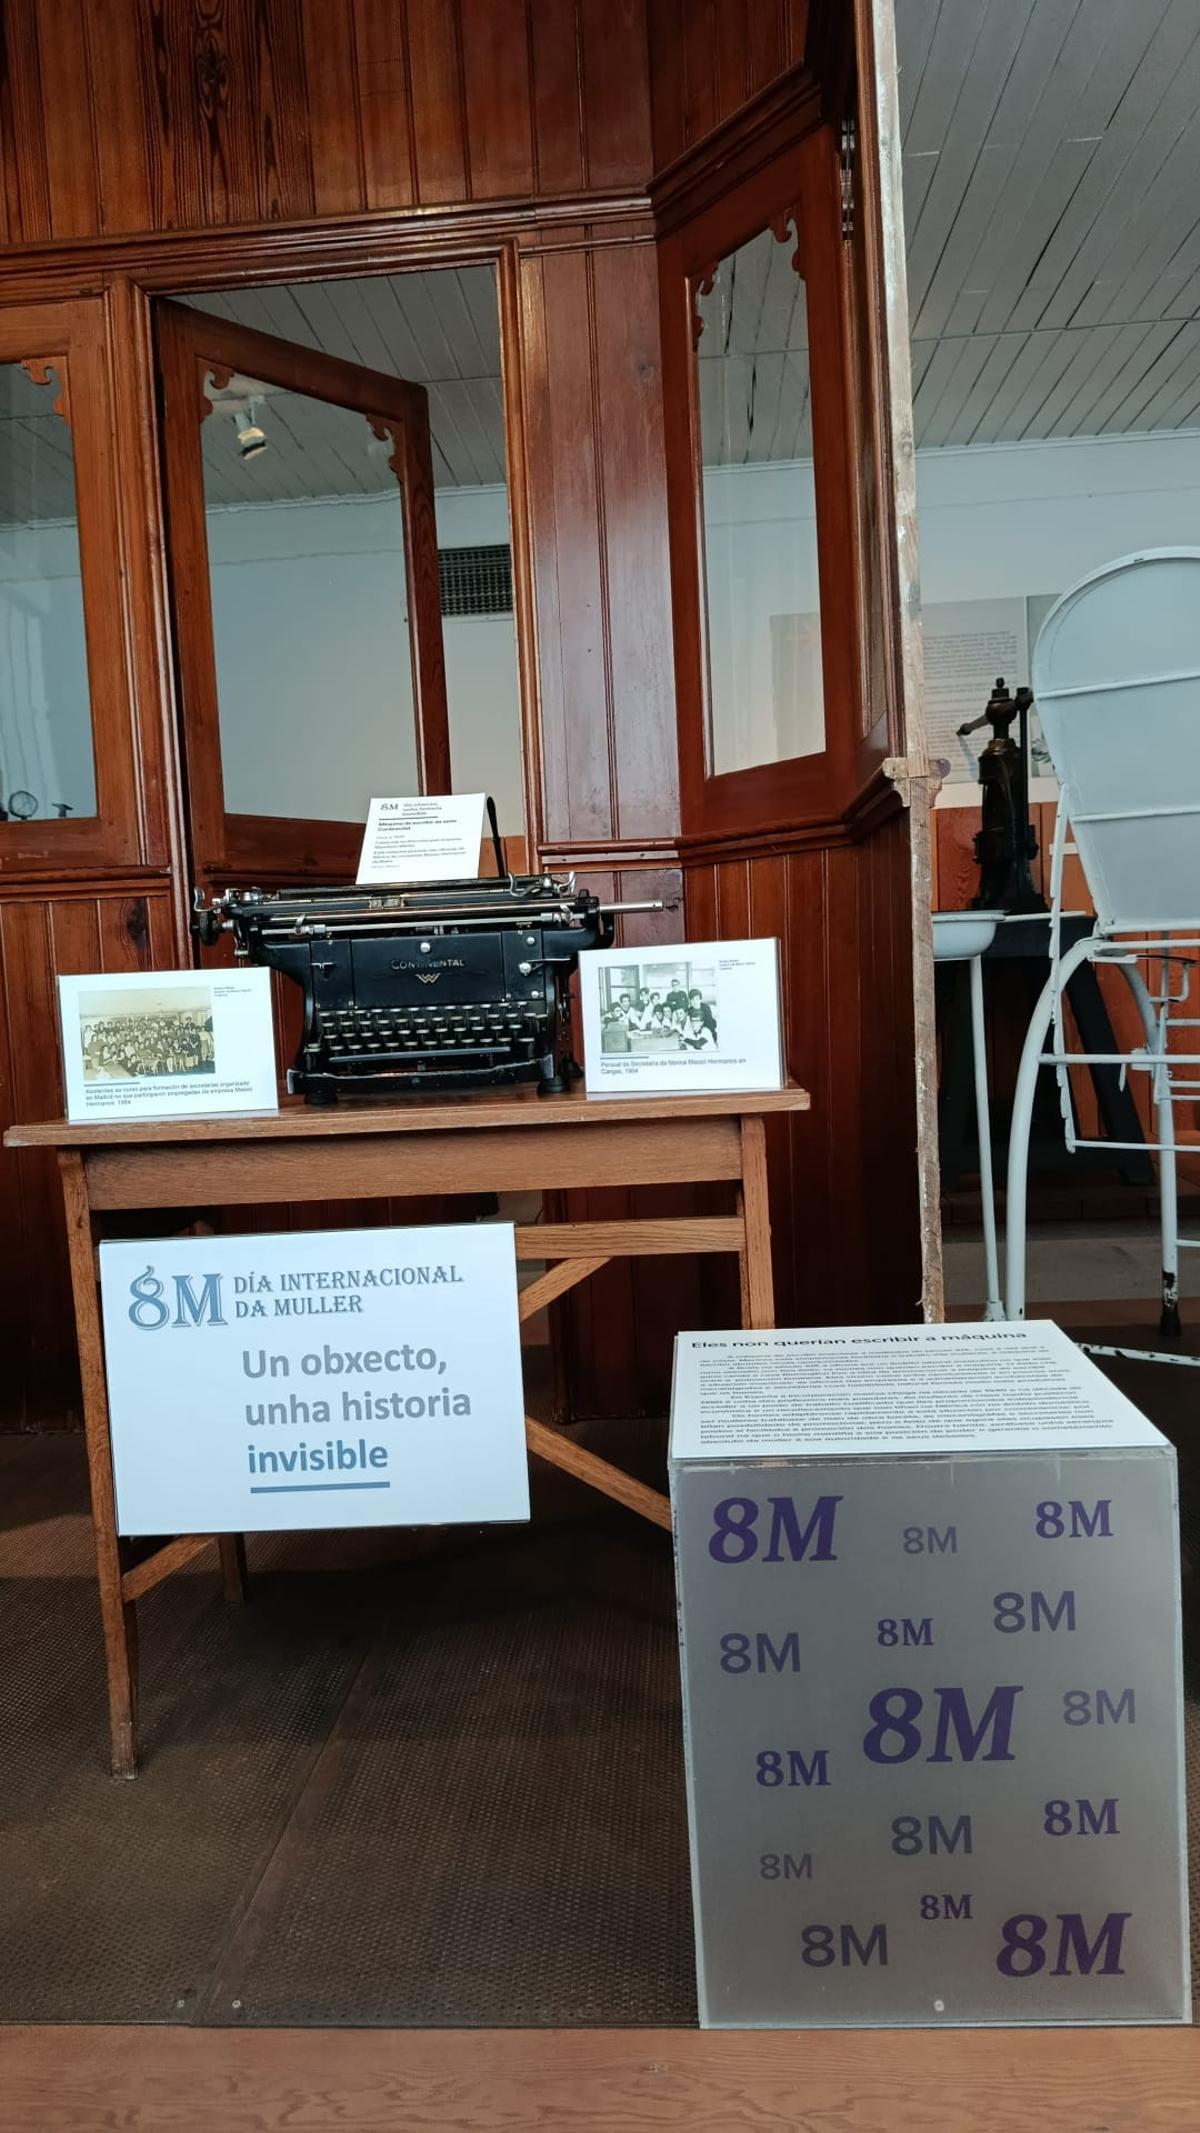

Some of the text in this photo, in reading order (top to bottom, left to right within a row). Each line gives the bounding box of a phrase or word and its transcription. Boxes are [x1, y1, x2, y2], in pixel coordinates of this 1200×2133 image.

[128, 1264, 228, 1331] 8M
[234, 1265, 464, 1294] DÍA INTERNACIONAL
[235, 1295, 363, 1318] DA MULLER
[851, 1335, 920, 1344] escribir
[942, 1331, 1027, 1342] máquina
[242, 1344, 447, 1379] Un obxecto,
[245, 1387, 471, 1426] unha historia
[248, 1439, 388, 1473] invisible
[708, 1495, 844, 1564] 8M
[1035, 1500, 1113, 1539] 8M
[903, 1526, 958, 1554] 8M
[993, 1590, 1076, 1633] 8M
[877, 1617, 934, 1647] 8M
[719, 1632, 801, 1674] 8M
[862, 1685, 1023, 1764] 8M
[1062, 1688, 1136, 1727] 8M
[756, 1750, 831, 1787] 8M
[891, 1815, 973, 1856] 8M
[1043, 1798, 1120, 1837] 8M
[759, 1853, 813, 1880] 8M
[920, 1893, 973, 1920] 8M
[801, 1923, 889, 1968] 8M
[996, 1912, 1132, 1977] 8M
